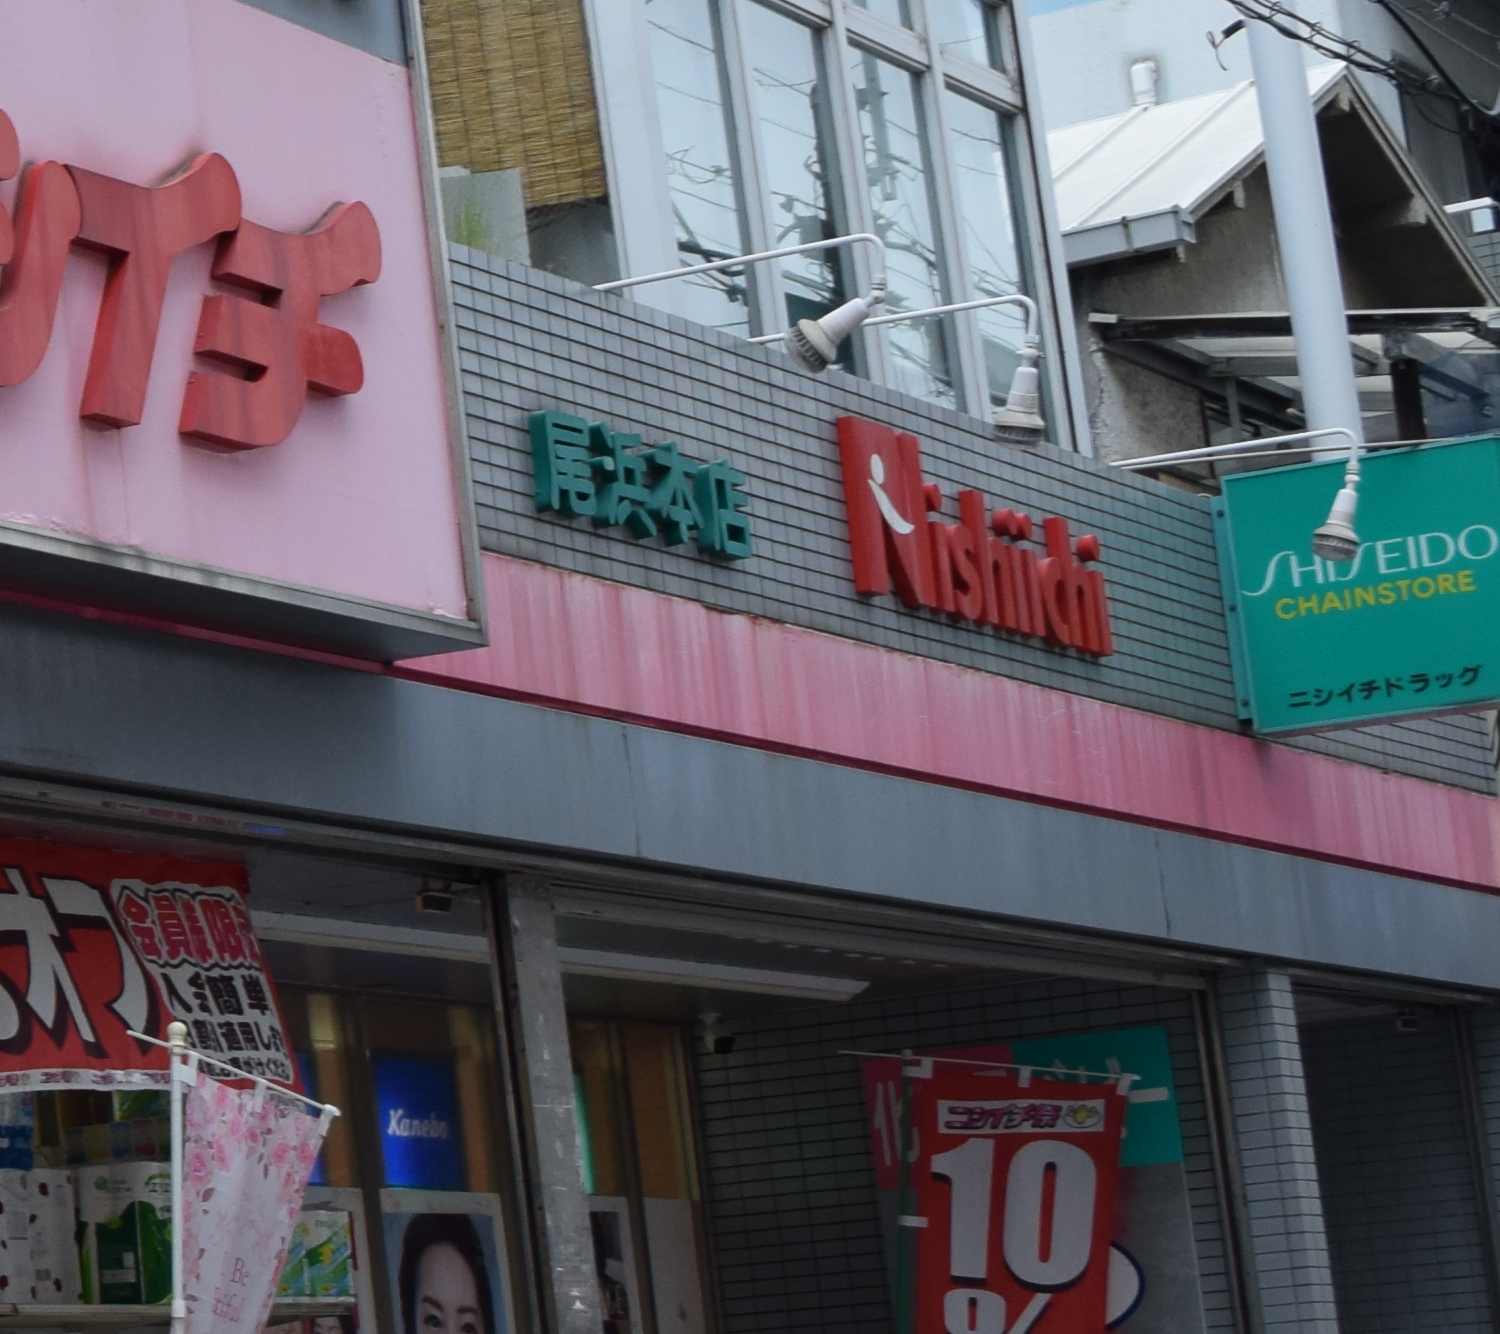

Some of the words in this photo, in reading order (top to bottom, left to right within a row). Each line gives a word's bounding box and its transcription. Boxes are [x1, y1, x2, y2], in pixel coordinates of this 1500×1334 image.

[528, 410, 753, 562] 尾浜本店
[835, 415, 1115, 657] Nishiichi
[1274, 570, 1477, 621] CHAINSTORE
[1287, 665, 1482, 709] ニシイチドラッグ
[387, 1109, 449, 1139] Kanebo
